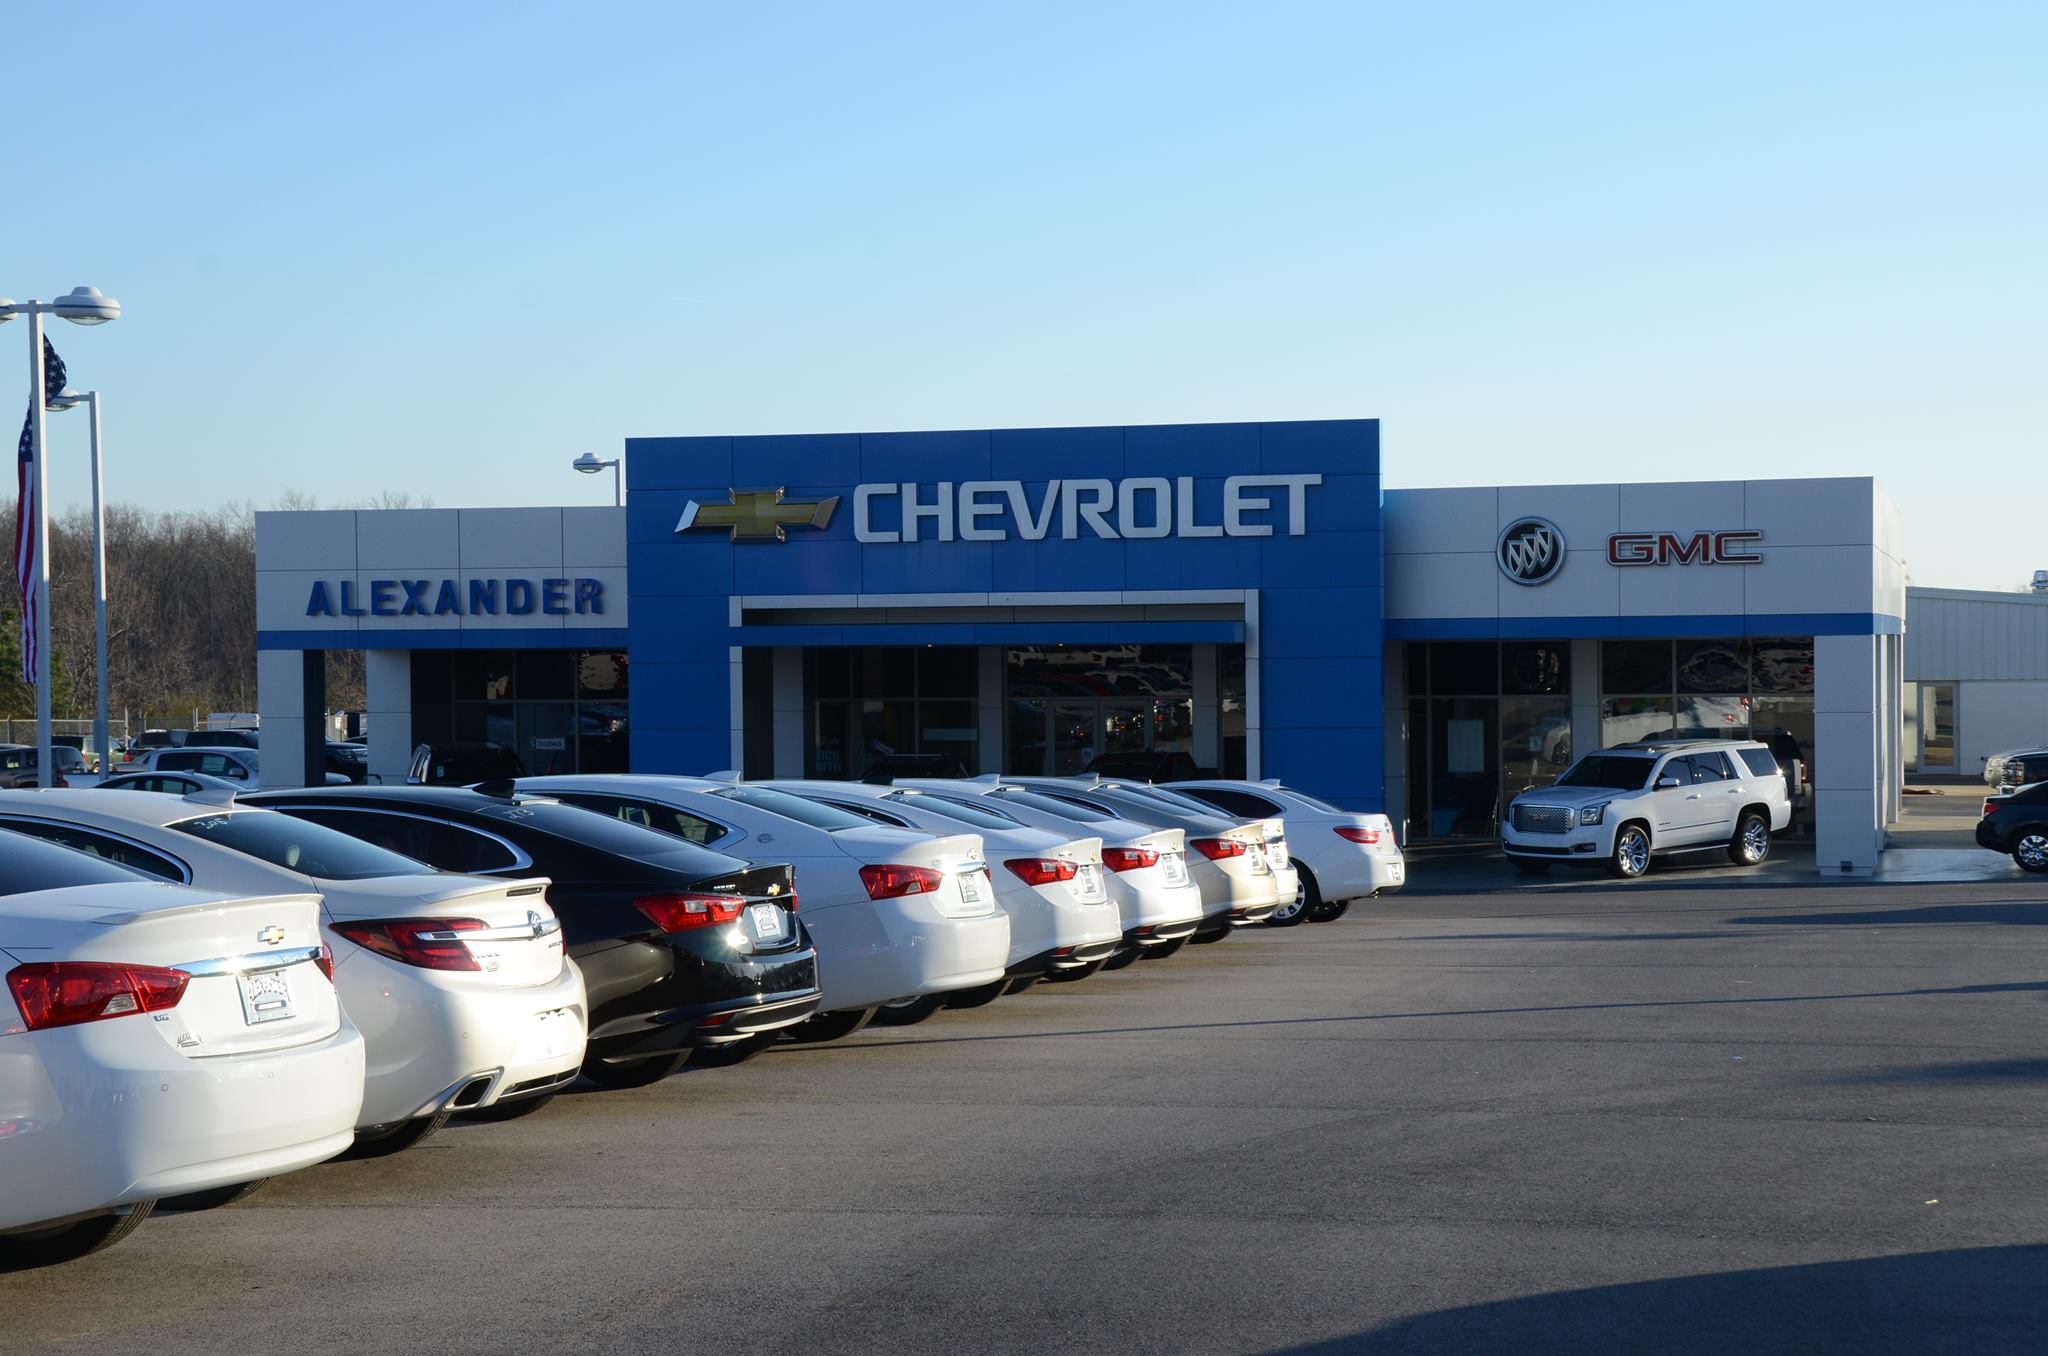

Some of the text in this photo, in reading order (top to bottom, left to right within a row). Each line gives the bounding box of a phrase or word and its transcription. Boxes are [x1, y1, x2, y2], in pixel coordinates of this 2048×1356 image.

[853, 473, 1323, 544] CHEVROLET
[1606, 529, 1763, 566] GMC
[305, 578, 605, 617] ALEXANDER
